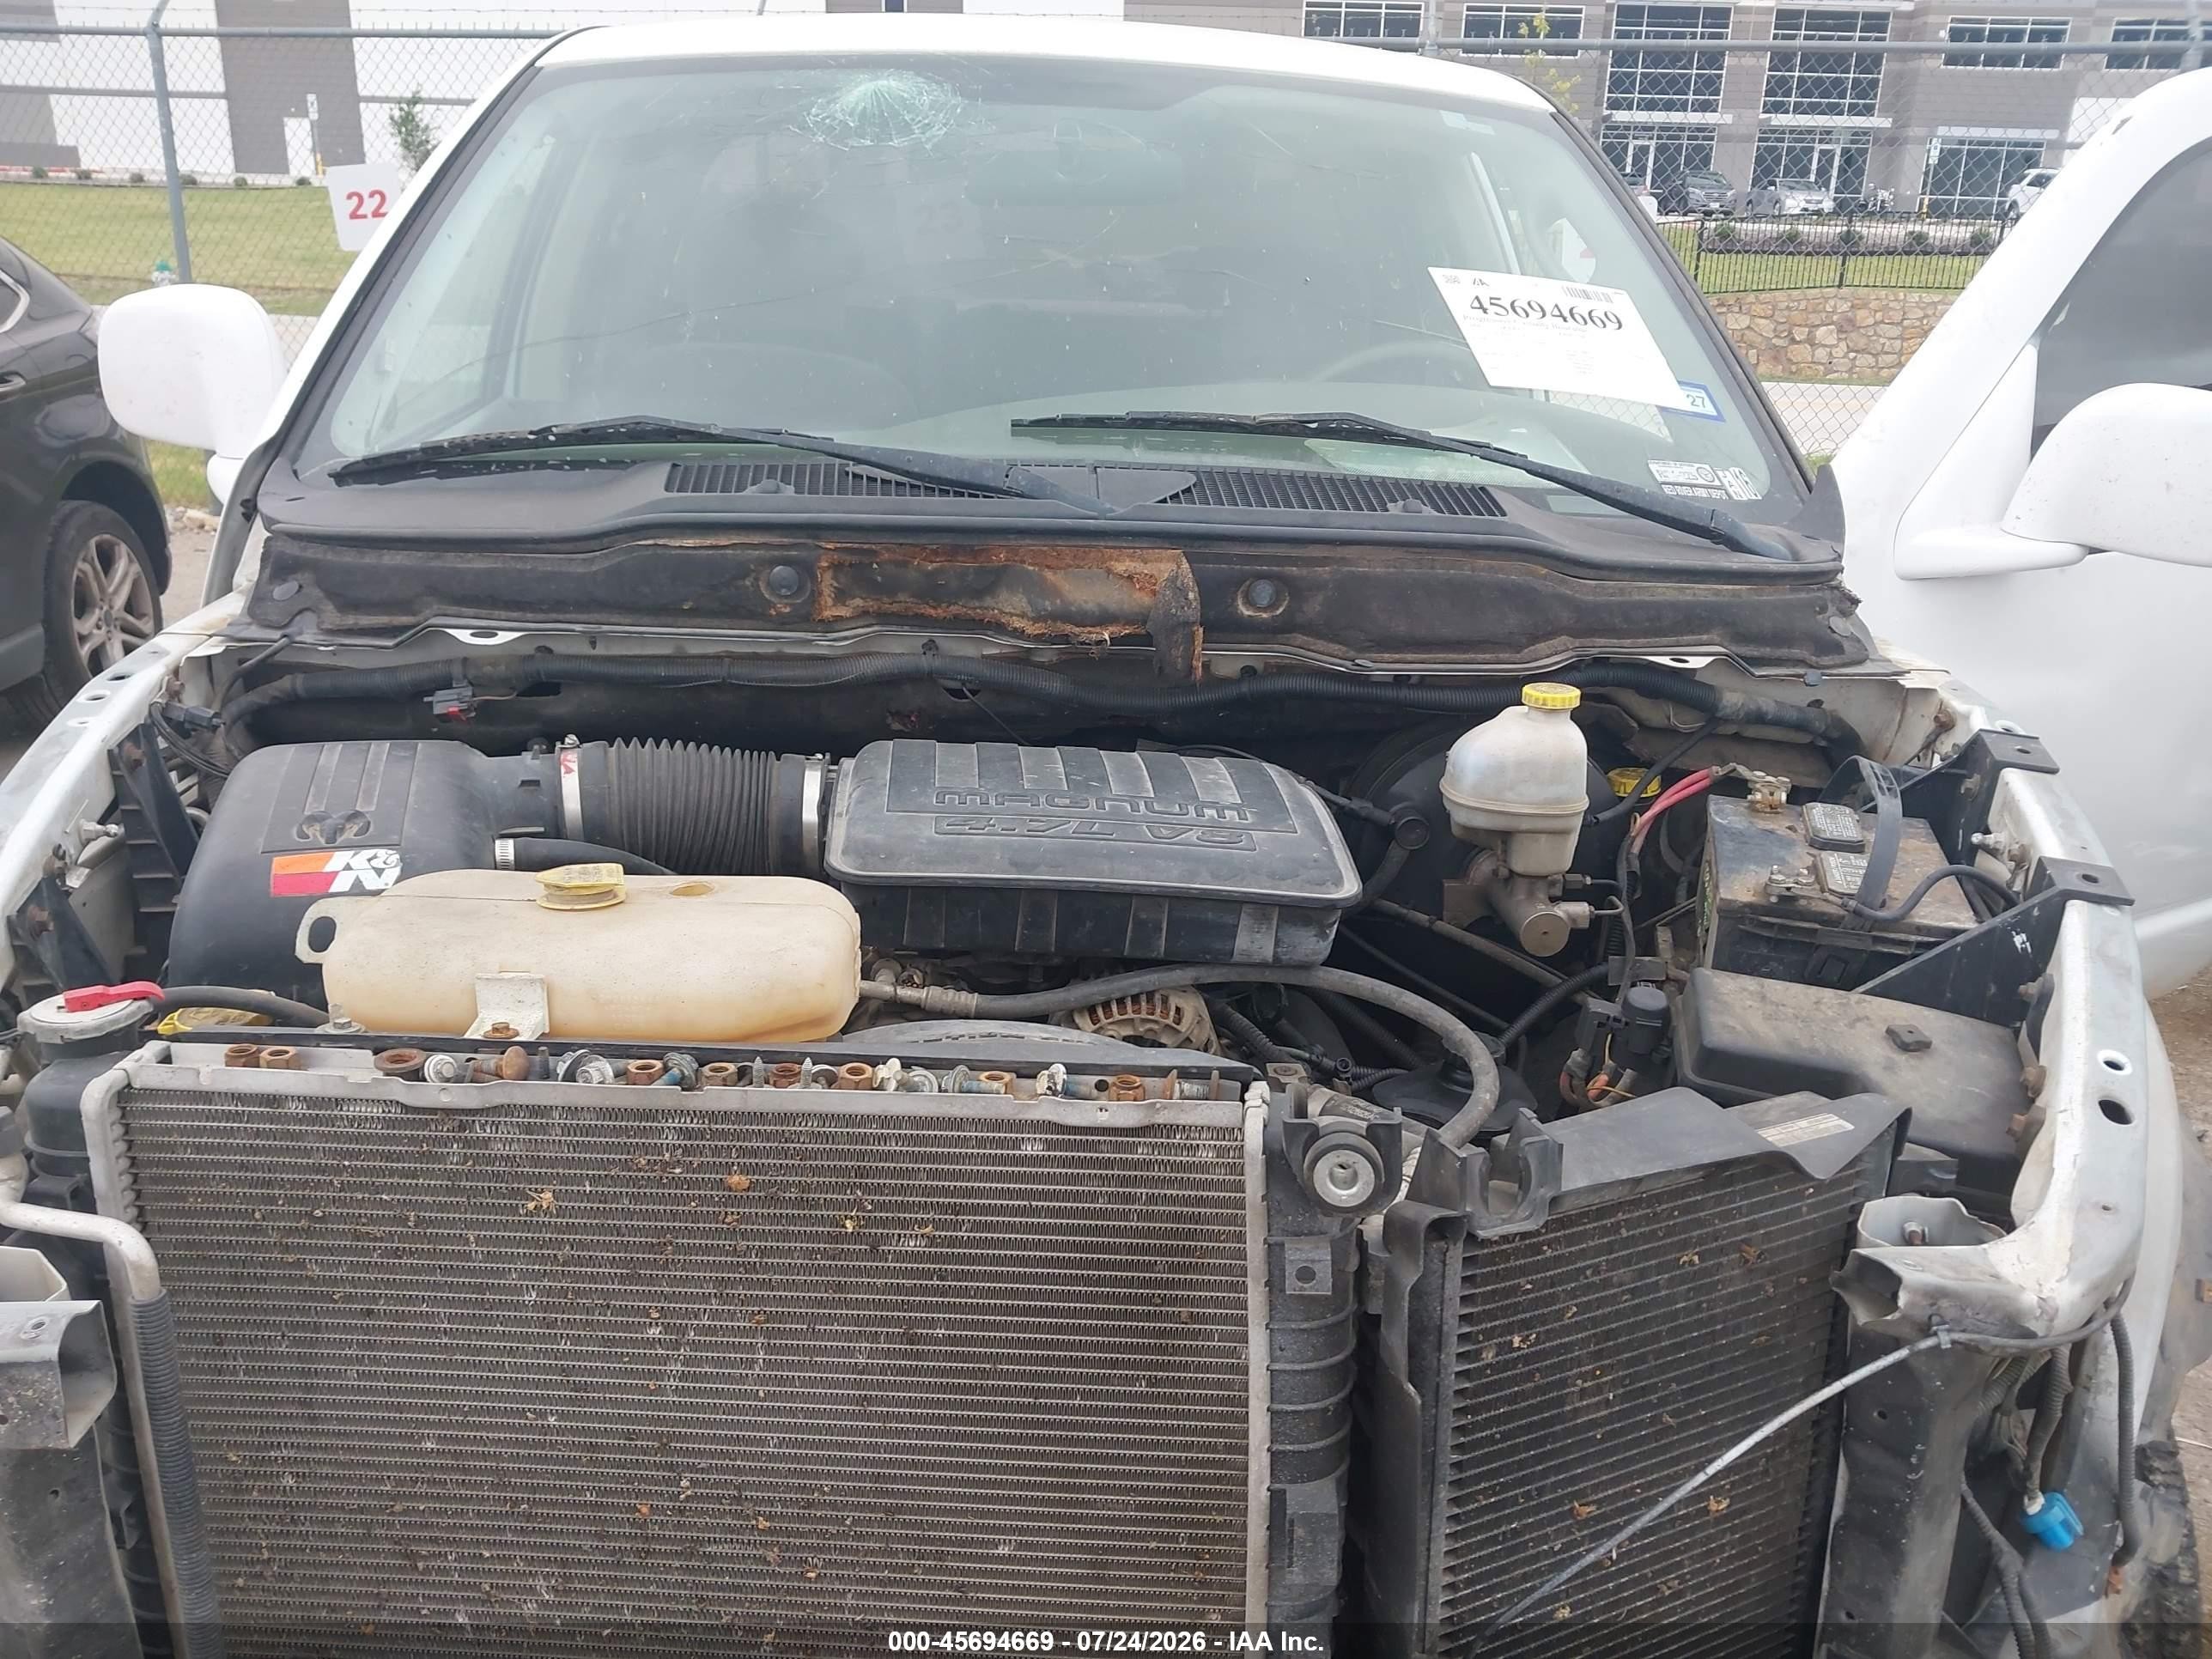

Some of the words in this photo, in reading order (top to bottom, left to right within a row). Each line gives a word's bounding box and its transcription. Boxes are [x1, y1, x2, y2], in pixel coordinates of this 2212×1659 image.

[345, 188, 389, 221] 22
[1469, 295, 1624, 331] 45694669
[1686, 393, 1706, 409] 27
[934, 788, 1250, 822] MAGNUM
